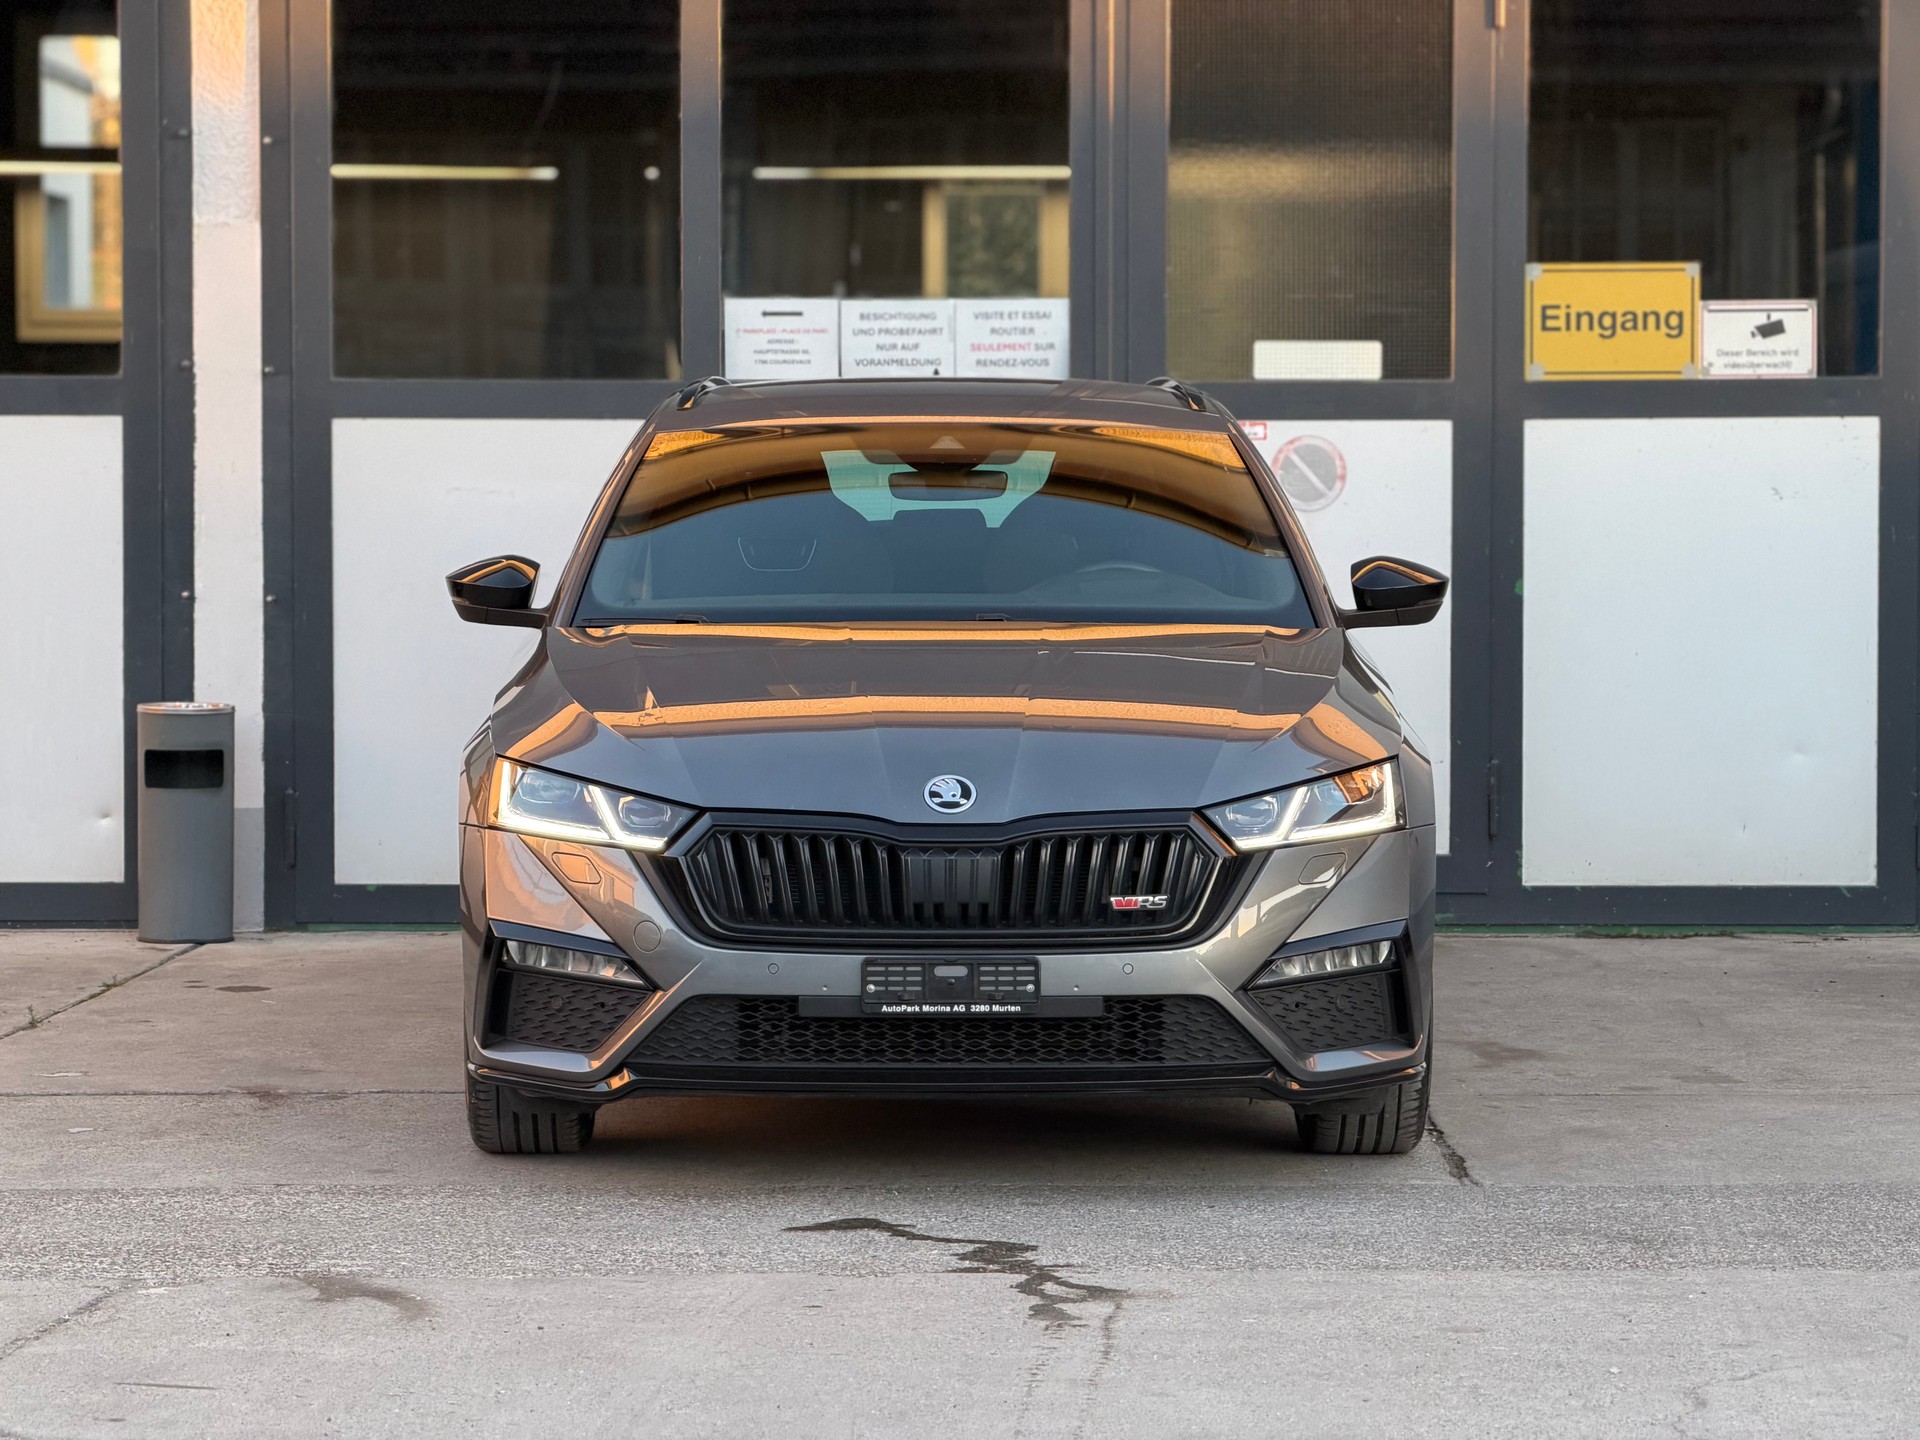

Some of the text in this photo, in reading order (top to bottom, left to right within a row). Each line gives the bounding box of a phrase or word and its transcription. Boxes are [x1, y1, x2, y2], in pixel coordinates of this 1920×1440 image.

[859, 312, 937, 321] BESICHTIGUNG
[973, 312, 1052, 320] VISITE ET ESSAI
[1540, 304, 1684, 340] Eingang
[852, 328, 944, 336] UND PROBEFAHRT
[990, 327, 1035, 336] ROUTIER
[876, 343, 920, 351] NUR AUF
[970, 343, 1056, 351] SEULEMENT SUR
[1716, 349, 1799, 357] Dieser Bereich wird
[855, 358, 942, 367] VORANMELDUNG
[976, 359, 1050, 367] RENDEZ-VOUS
[882, 1004, 1021, 1012] AutoPark Morina AG 3280 Murten
